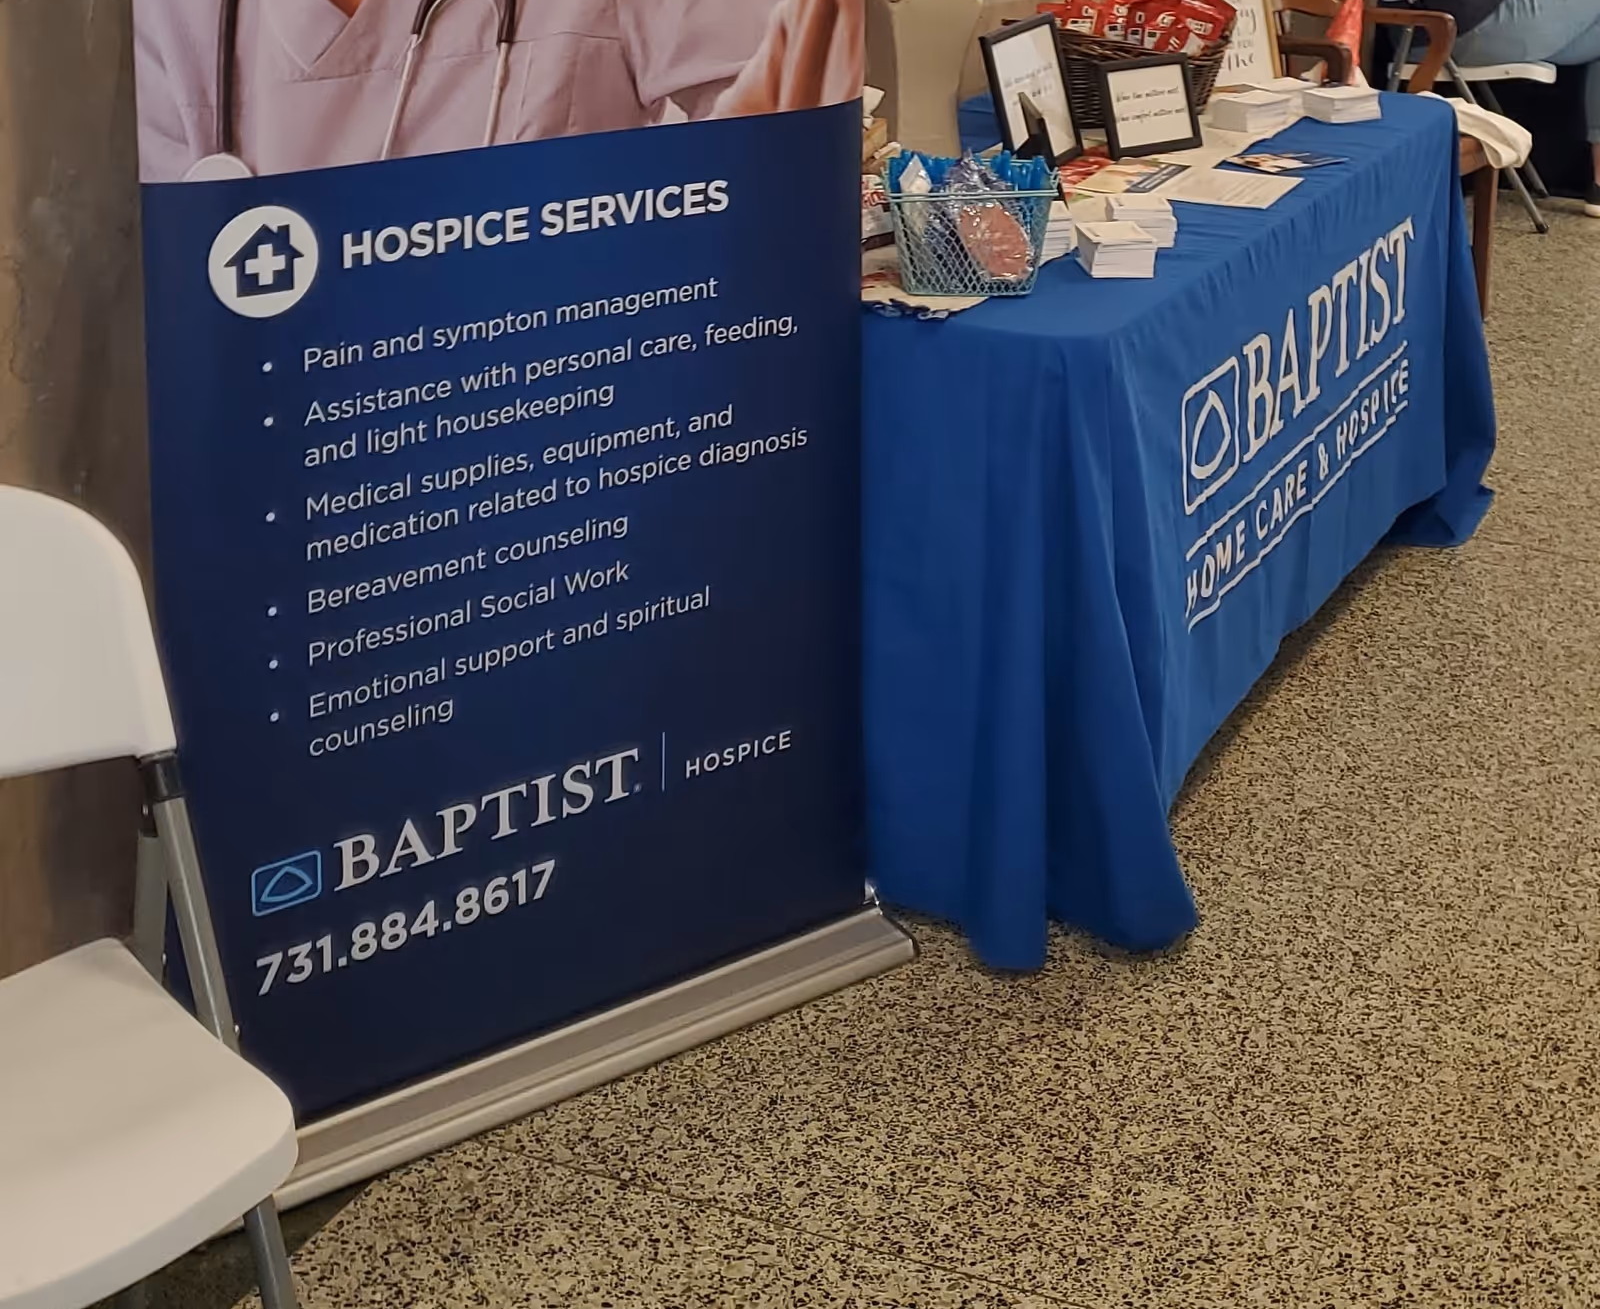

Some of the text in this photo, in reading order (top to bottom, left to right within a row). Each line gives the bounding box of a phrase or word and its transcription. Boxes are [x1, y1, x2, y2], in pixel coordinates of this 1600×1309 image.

[342, 179, 730, 269] HOSPICE SERVICES
[304, 277, 719, 373] Pain and sympton management
[304, 315, 798, 427] Assistance with personal care, feeding,
[1242, 215, 1415, 463] BAPTIST
[304, 384, 615, 467] and light housekeeping
[306, 403, 733, 521] Medical supplies, equipment, and
[307, 426, 808, 561] medication related to hospice diagnosis
[1185, 357, 1410, 619] HOME CARE & HOSPICE
[308, 516, 628, 614] Bereavement counseling
[309, 560, 629, 666] Professional Social Work
[309, 585, 710, 718] Emotional support and spiritual
[309, 699, 454, 756] counseling
[333, 728, 793, 892] BAPTIST HOSPICE
[256, 859, 556, 996] 731.884.8617
